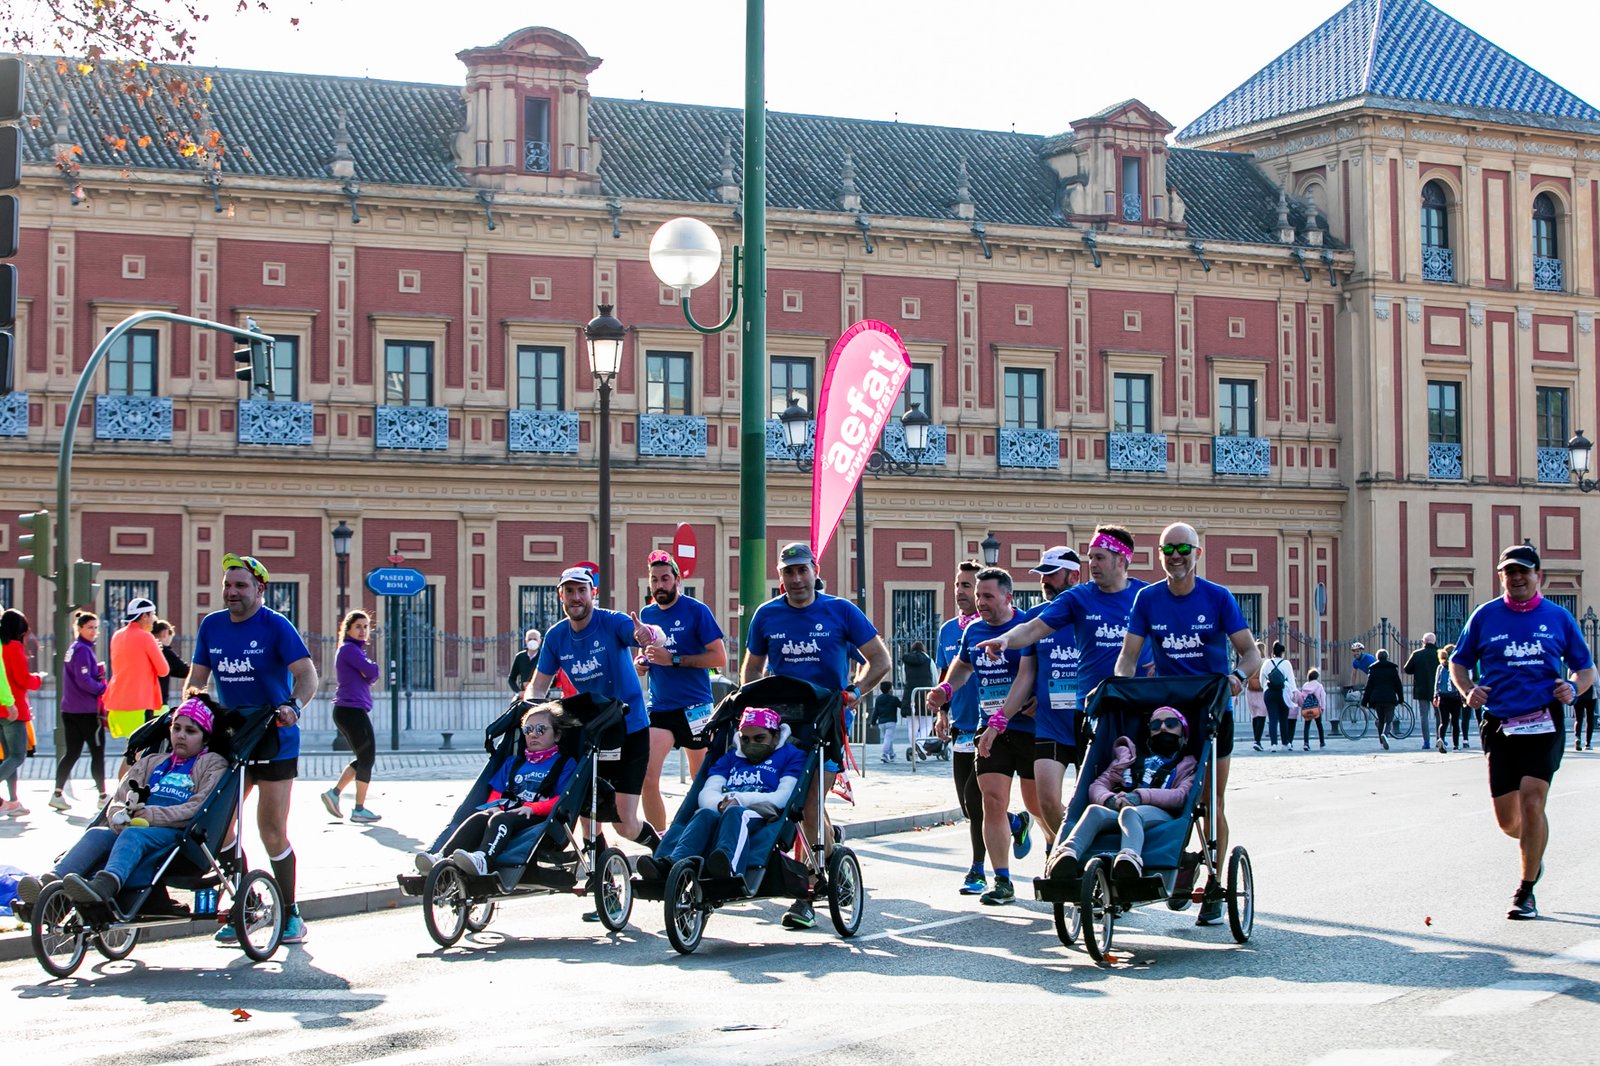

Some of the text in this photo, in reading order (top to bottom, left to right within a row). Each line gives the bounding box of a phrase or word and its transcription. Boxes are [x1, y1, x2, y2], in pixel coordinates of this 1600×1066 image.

[828, 349, 899, 474] aefat
[845, 363, 906, 484] www.aefat.es
[988, 677, 1012, 685] ZURICH
[160, 785, 189, 799] ZURICH
